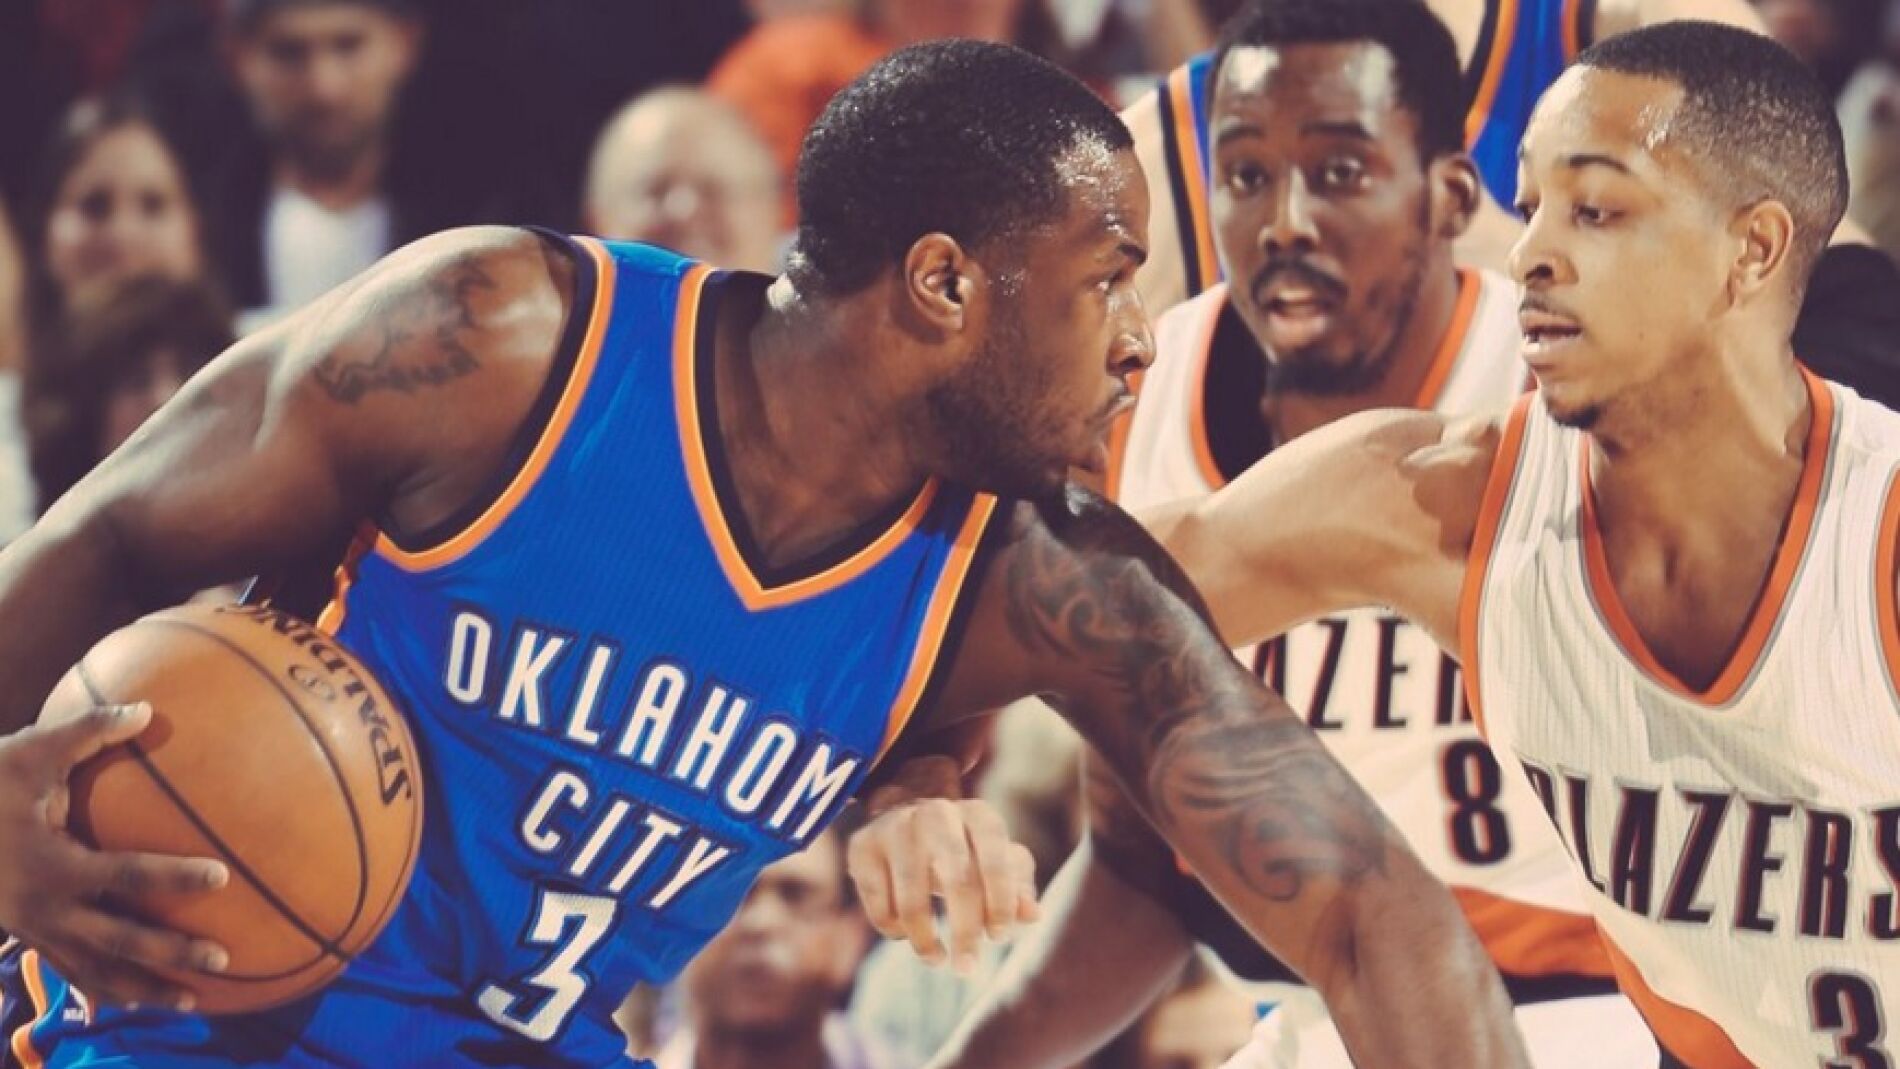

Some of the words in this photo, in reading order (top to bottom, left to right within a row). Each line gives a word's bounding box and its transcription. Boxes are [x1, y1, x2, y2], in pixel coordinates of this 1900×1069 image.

[520, 769, 732, 909] CITY
[1438, 738, 1512, 865] 8
[475, 889, 618, 1042] 3
